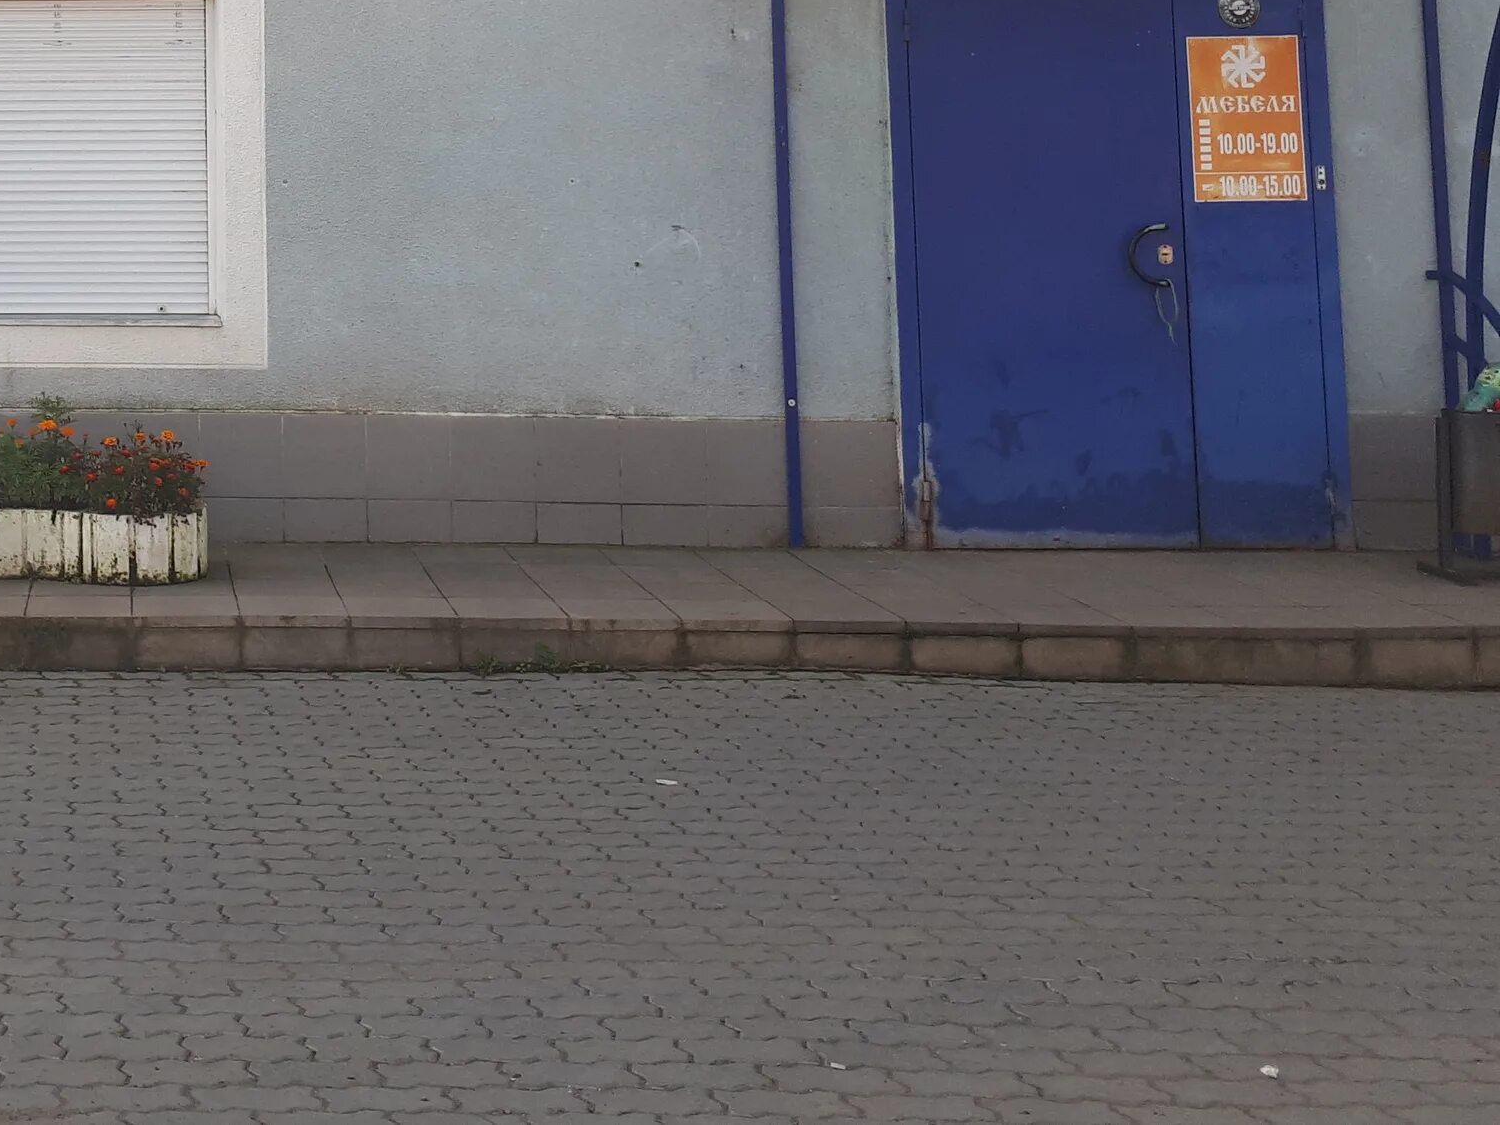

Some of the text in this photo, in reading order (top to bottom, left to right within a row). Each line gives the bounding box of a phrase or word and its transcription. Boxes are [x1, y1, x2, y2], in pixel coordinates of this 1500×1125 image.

[1196, 95, 1297, 114] МЕБЕЛЯ
[1217, 132, 1298, 155] 10.00-19.00
[1219, 175, 1301, 196] 10.00-15.00
